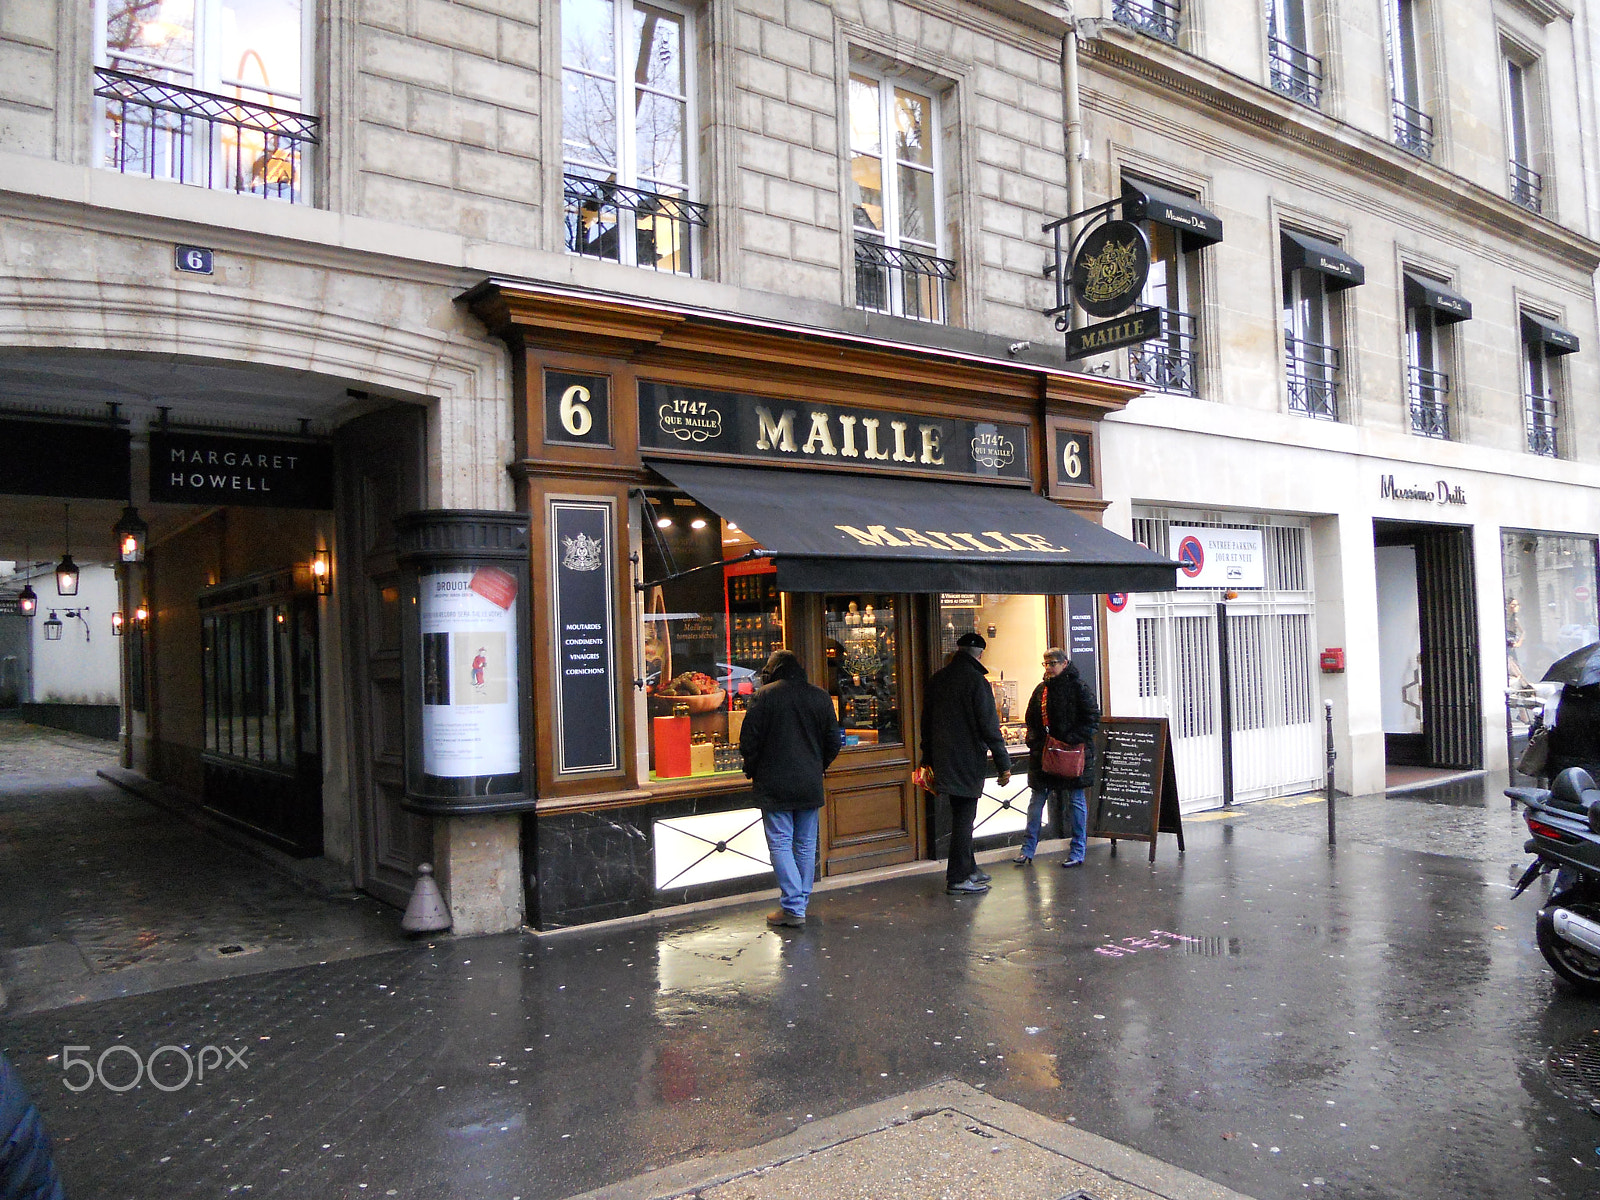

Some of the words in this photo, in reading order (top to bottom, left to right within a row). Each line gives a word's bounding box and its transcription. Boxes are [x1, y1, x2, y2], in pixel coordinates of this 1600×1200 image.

[187, 250, 203, 269] 6
[1081, 319, 1145, 350] MAILLE
[560, 384, 593, 436] 6
[673, 399, 708, 416] 1747
[664, 415, 683, 425] QUE
[685, 417, 717, 428] MAILLE
[755, 405, 945, 466] MAILLE
[980, 433, 1004, 447] 1747
[171, 448, 298, 470] MARGARET
[975, 447, 986, 455] QUI
[1063, 440, 1082, 479] 6
[171, 472, 271, 491] HOWELL
[1380, 474, 1435, 502] Massimo
[1435, 480, 1468, 505] Dutti
[834, 524, 1071, 553] MAILLE
[1232, 541, 1257, 551] PARKING
[436, 581, 468, 591] DROUOT
[565, 638, 604, 646] CONDIMENTS
